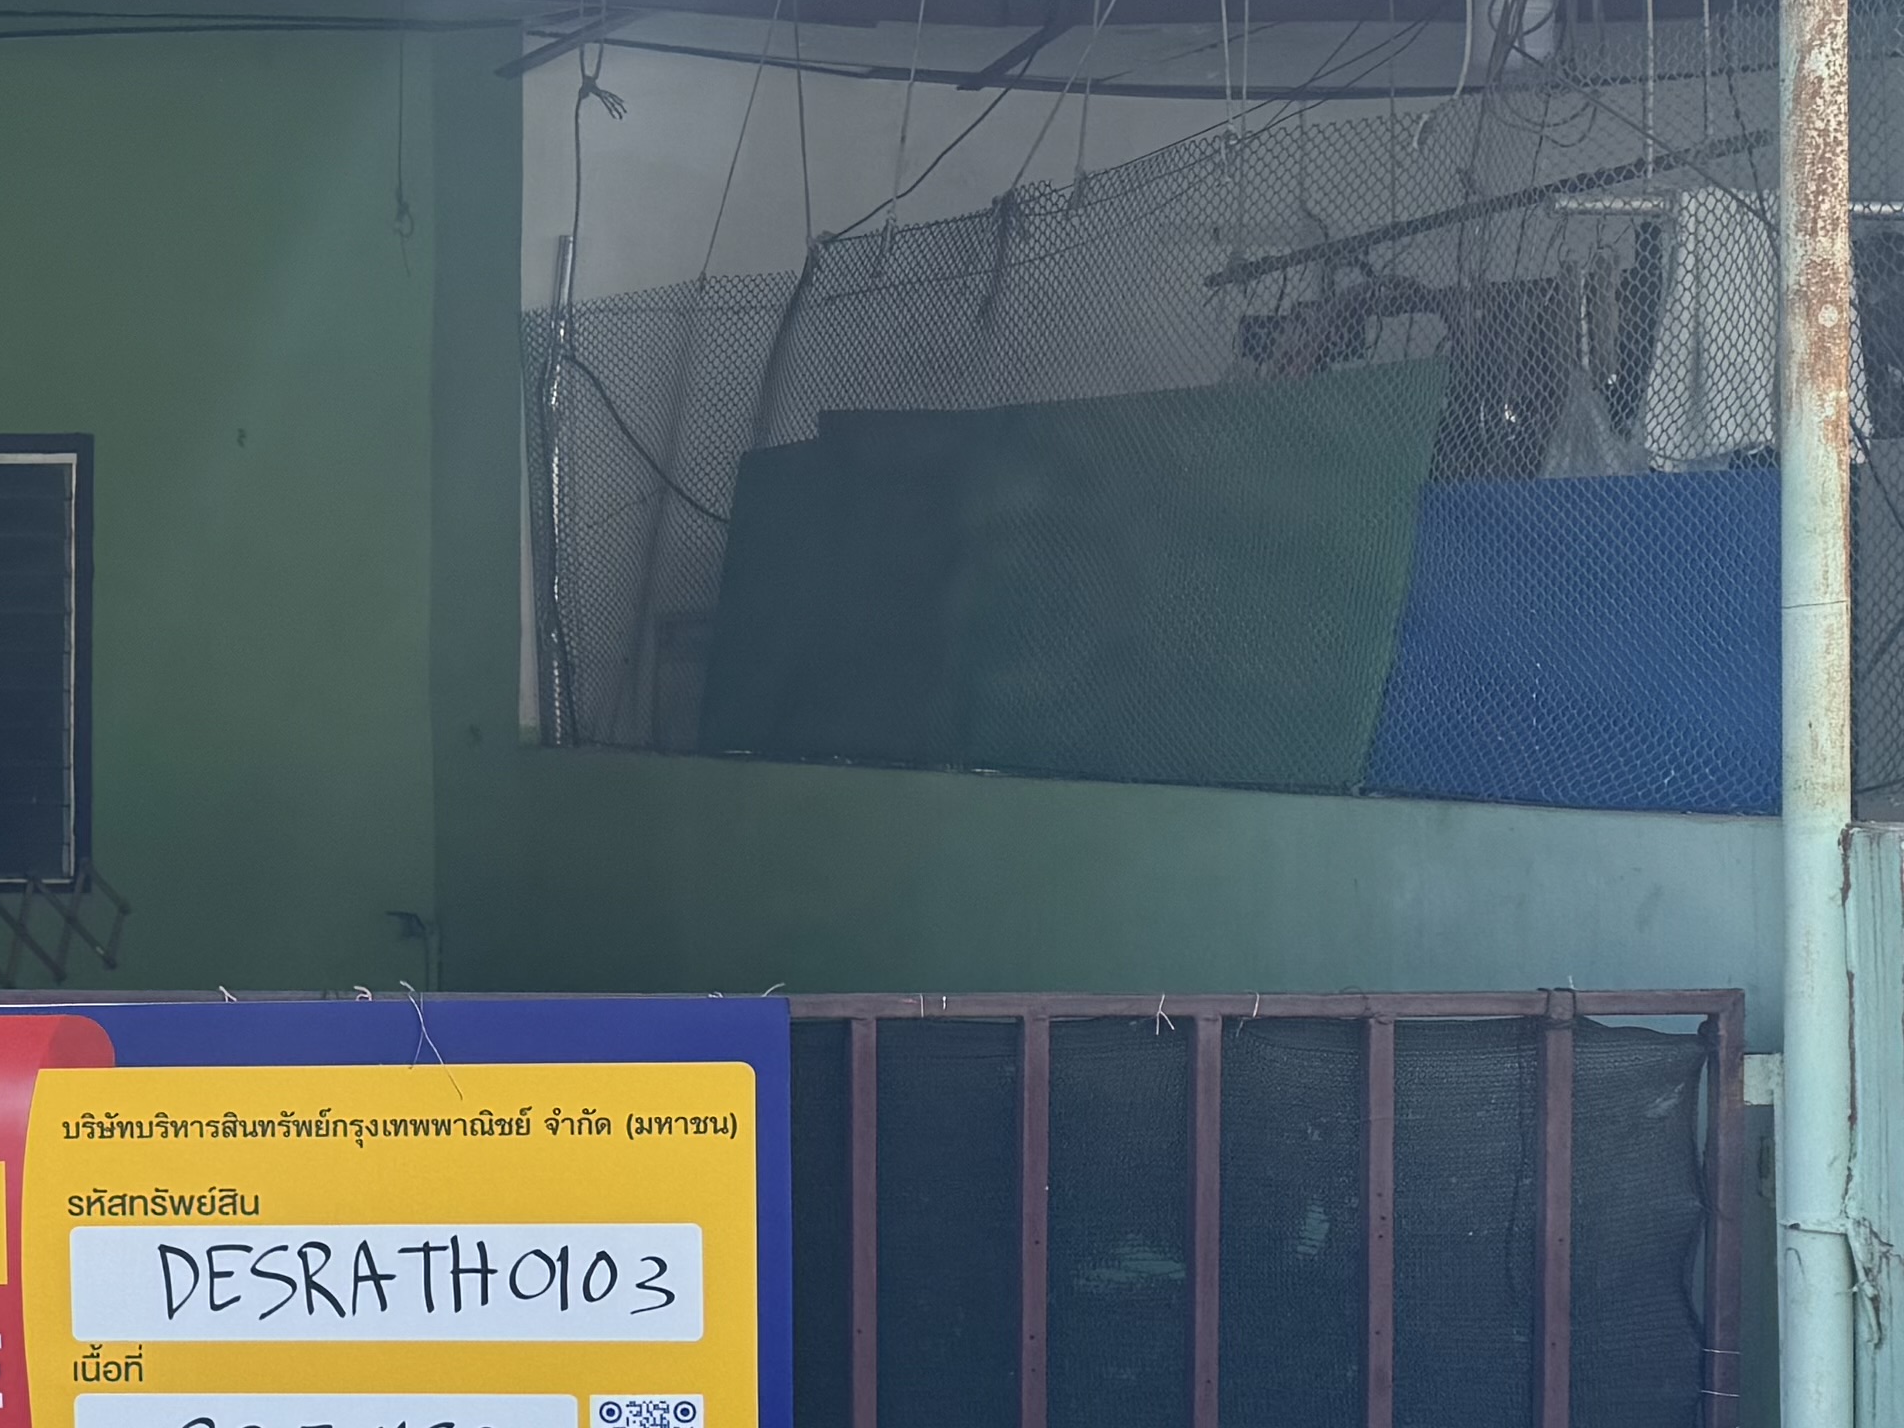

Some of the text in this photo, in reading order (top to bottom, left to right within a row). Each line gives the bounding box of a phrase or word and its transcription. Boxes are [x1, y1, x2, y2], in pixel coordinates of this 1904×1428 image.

[62, 1106, 738, 1148] บริษัทบริหารสินทรัพย์กรุงเทพพาณิชย์ จำกัด (มหาชน)
[67, 1186, 260, 1217] รหัสทรัพย์สิน
[73, 1343, 144, 1382] เนื้อที่
